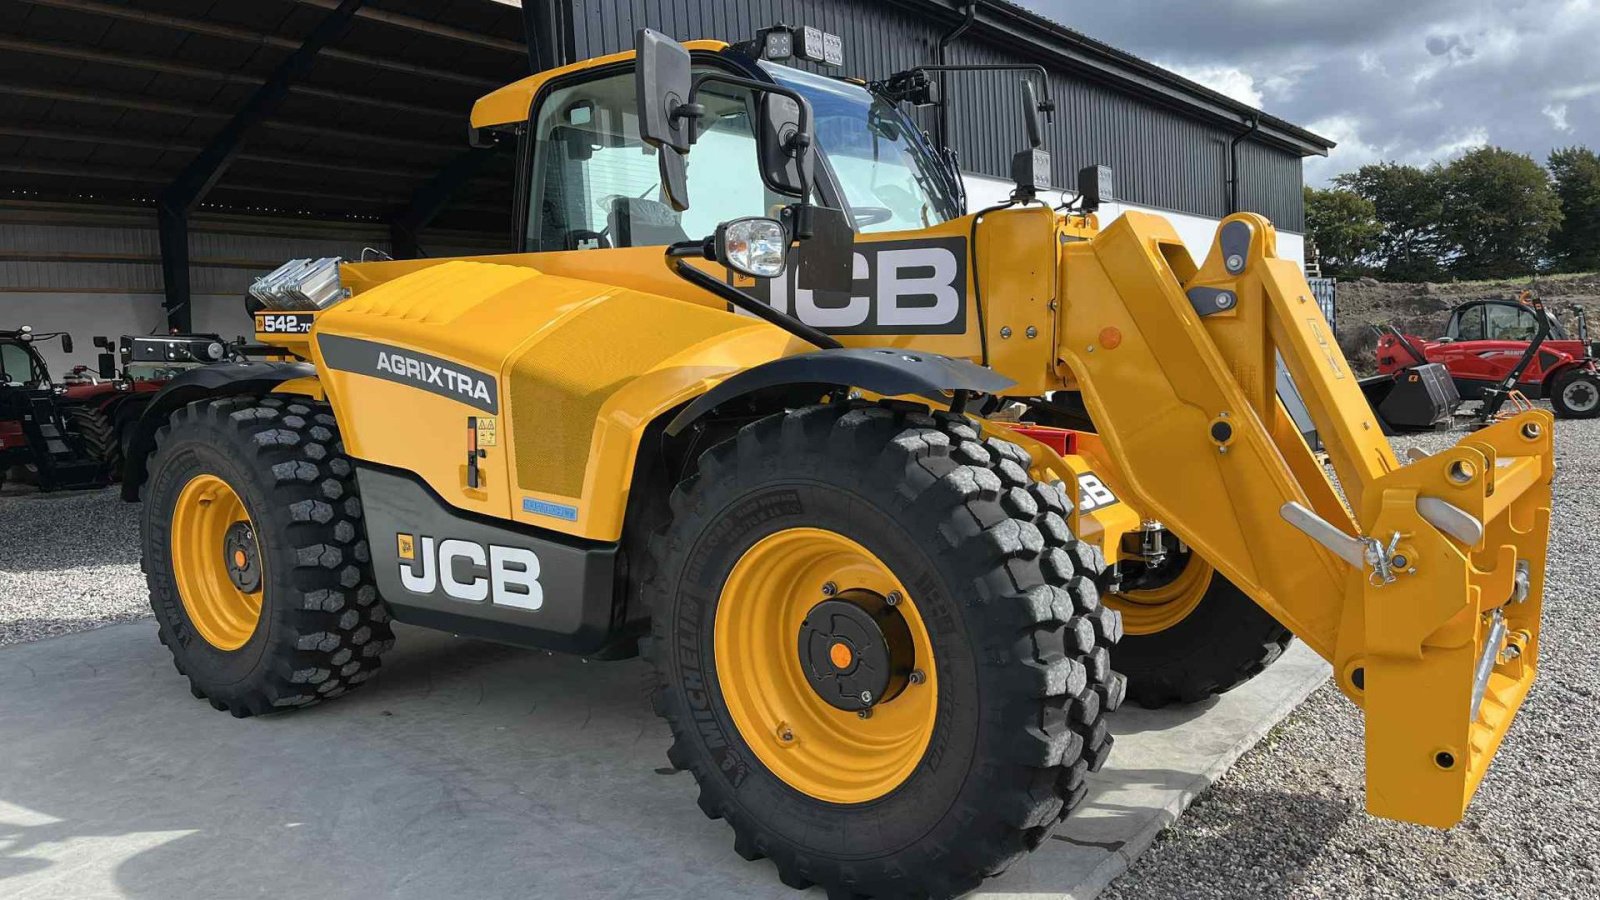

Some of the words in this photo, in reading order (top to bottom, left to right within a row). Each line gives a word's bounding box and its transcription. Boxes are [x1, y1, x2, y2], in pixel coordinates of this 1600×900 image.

[377, 352, 492, 404] AGRIXTRA
[151, 524, 181, 626] MICHELIN
[400, 537, 543, 610] JCB
[679, 593, 729, 750] MICHELIN
